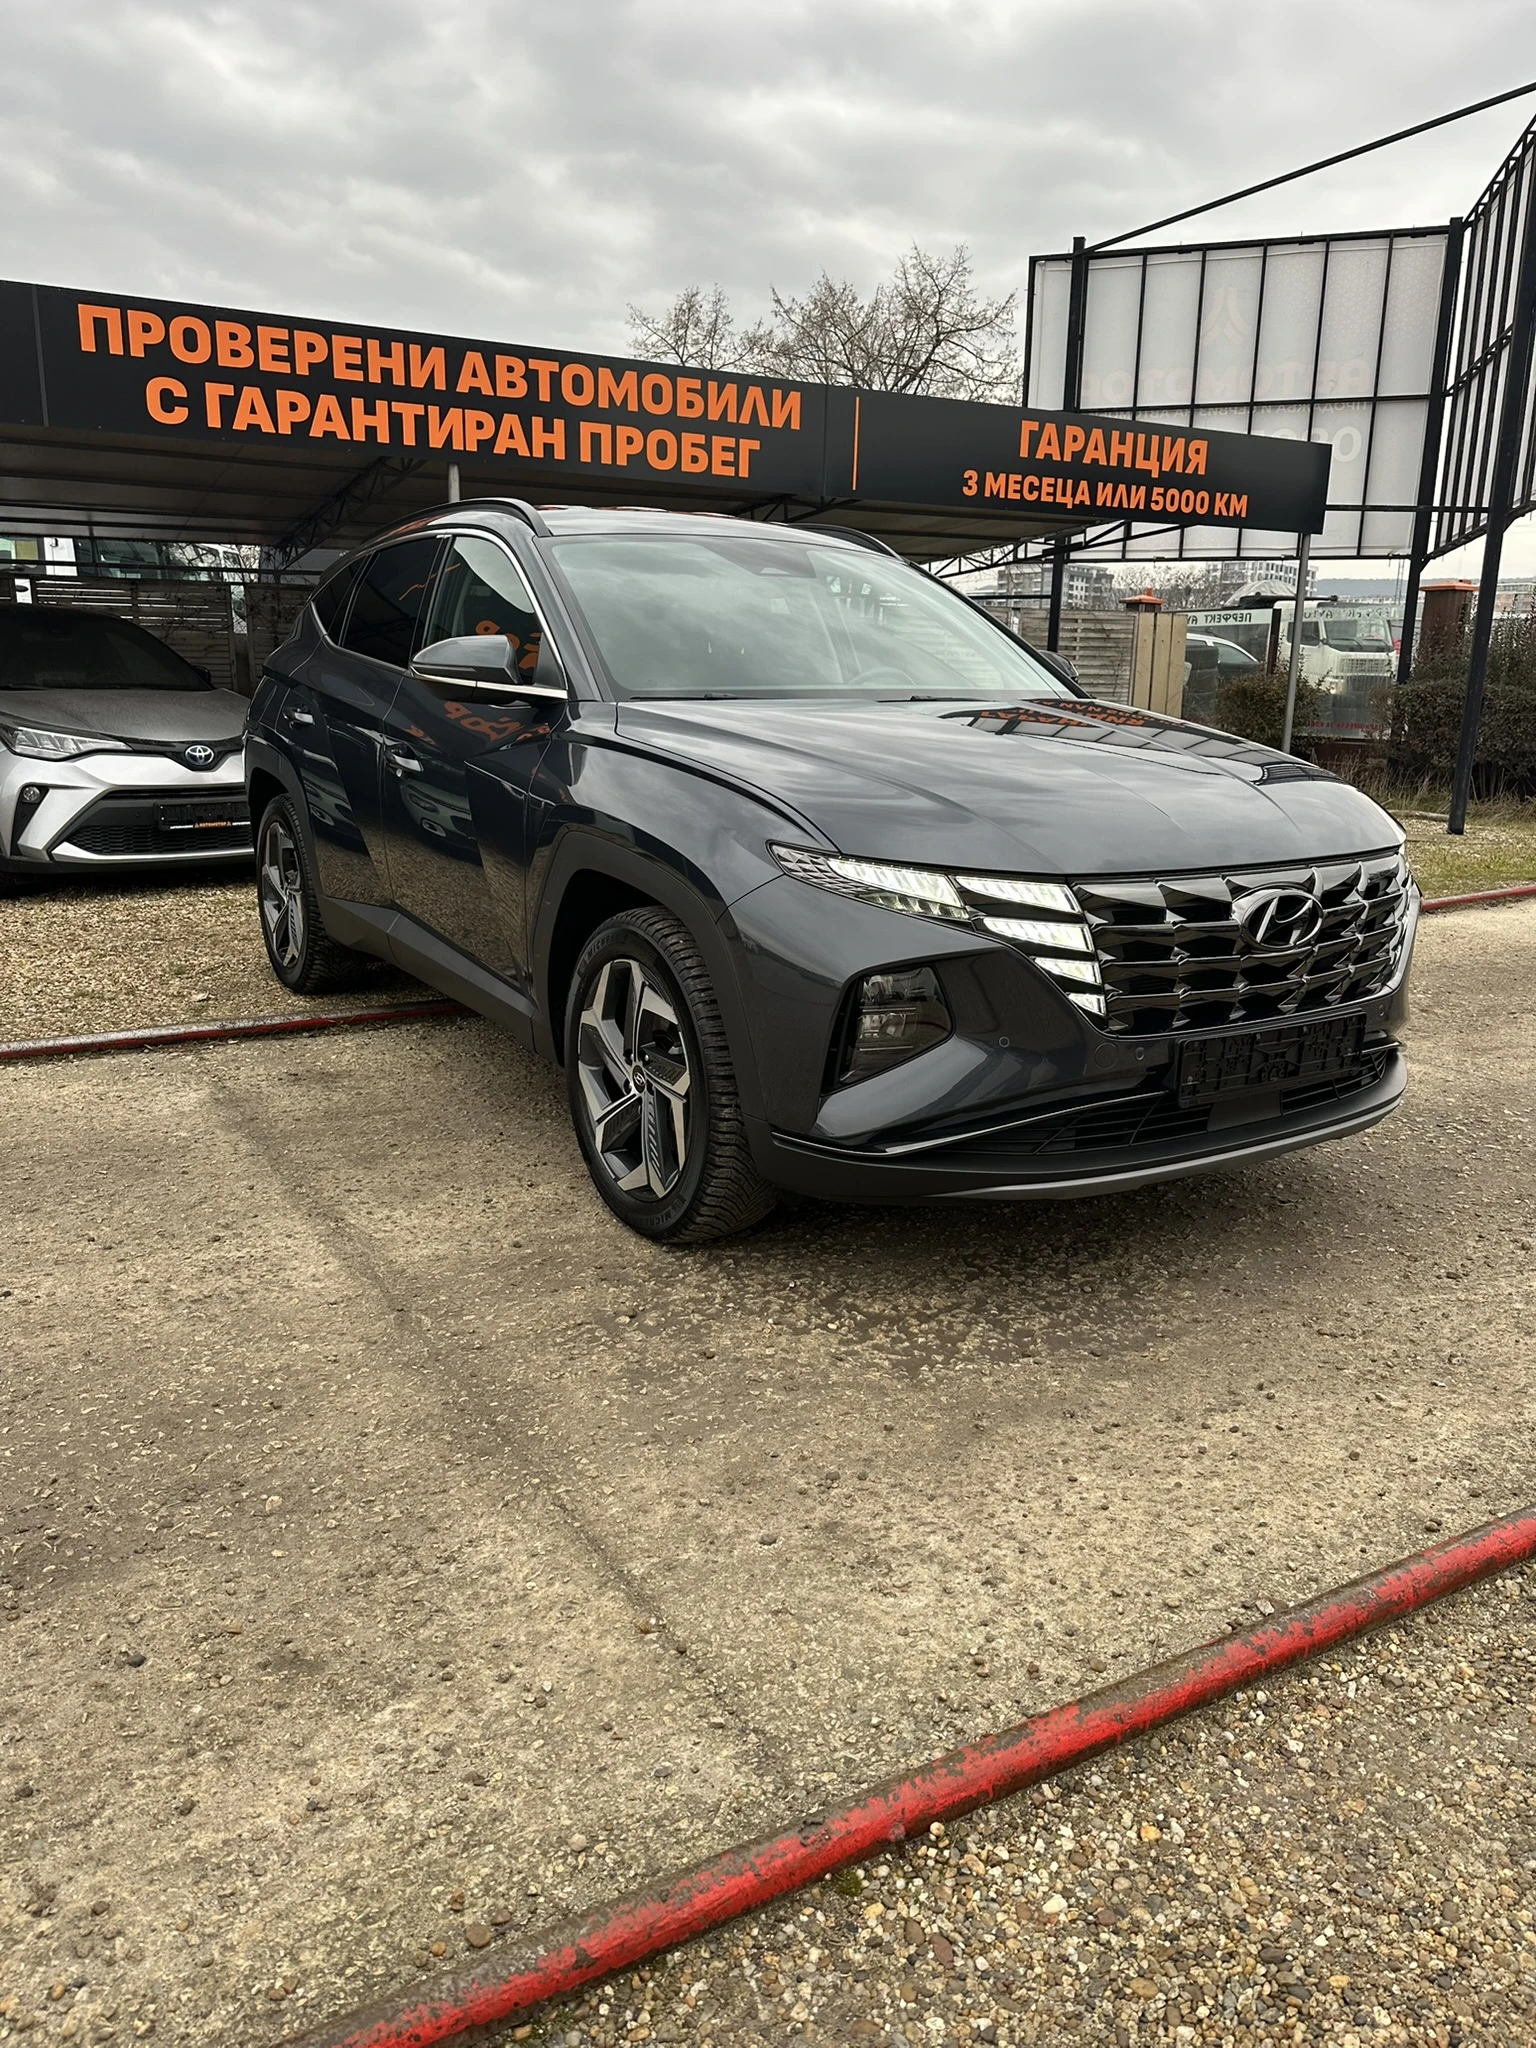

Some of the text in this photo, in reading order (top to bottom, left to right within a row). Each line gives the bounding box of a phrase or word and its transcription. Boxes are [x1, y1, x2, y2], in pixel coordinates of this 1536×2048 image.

[77, 303, 801, 430] ПРОВЕРЕНИ АВТОМОБИЛИ
[145, 376, 761, 478] С ГАРАНТИРАН ПРОБЕГ
[1019, 420, 1208, 479] ГАРАНЦИЯ
[962, 469, 1248, 518] 3 МЕСЕЦА ИЛИ 5000 КМ
